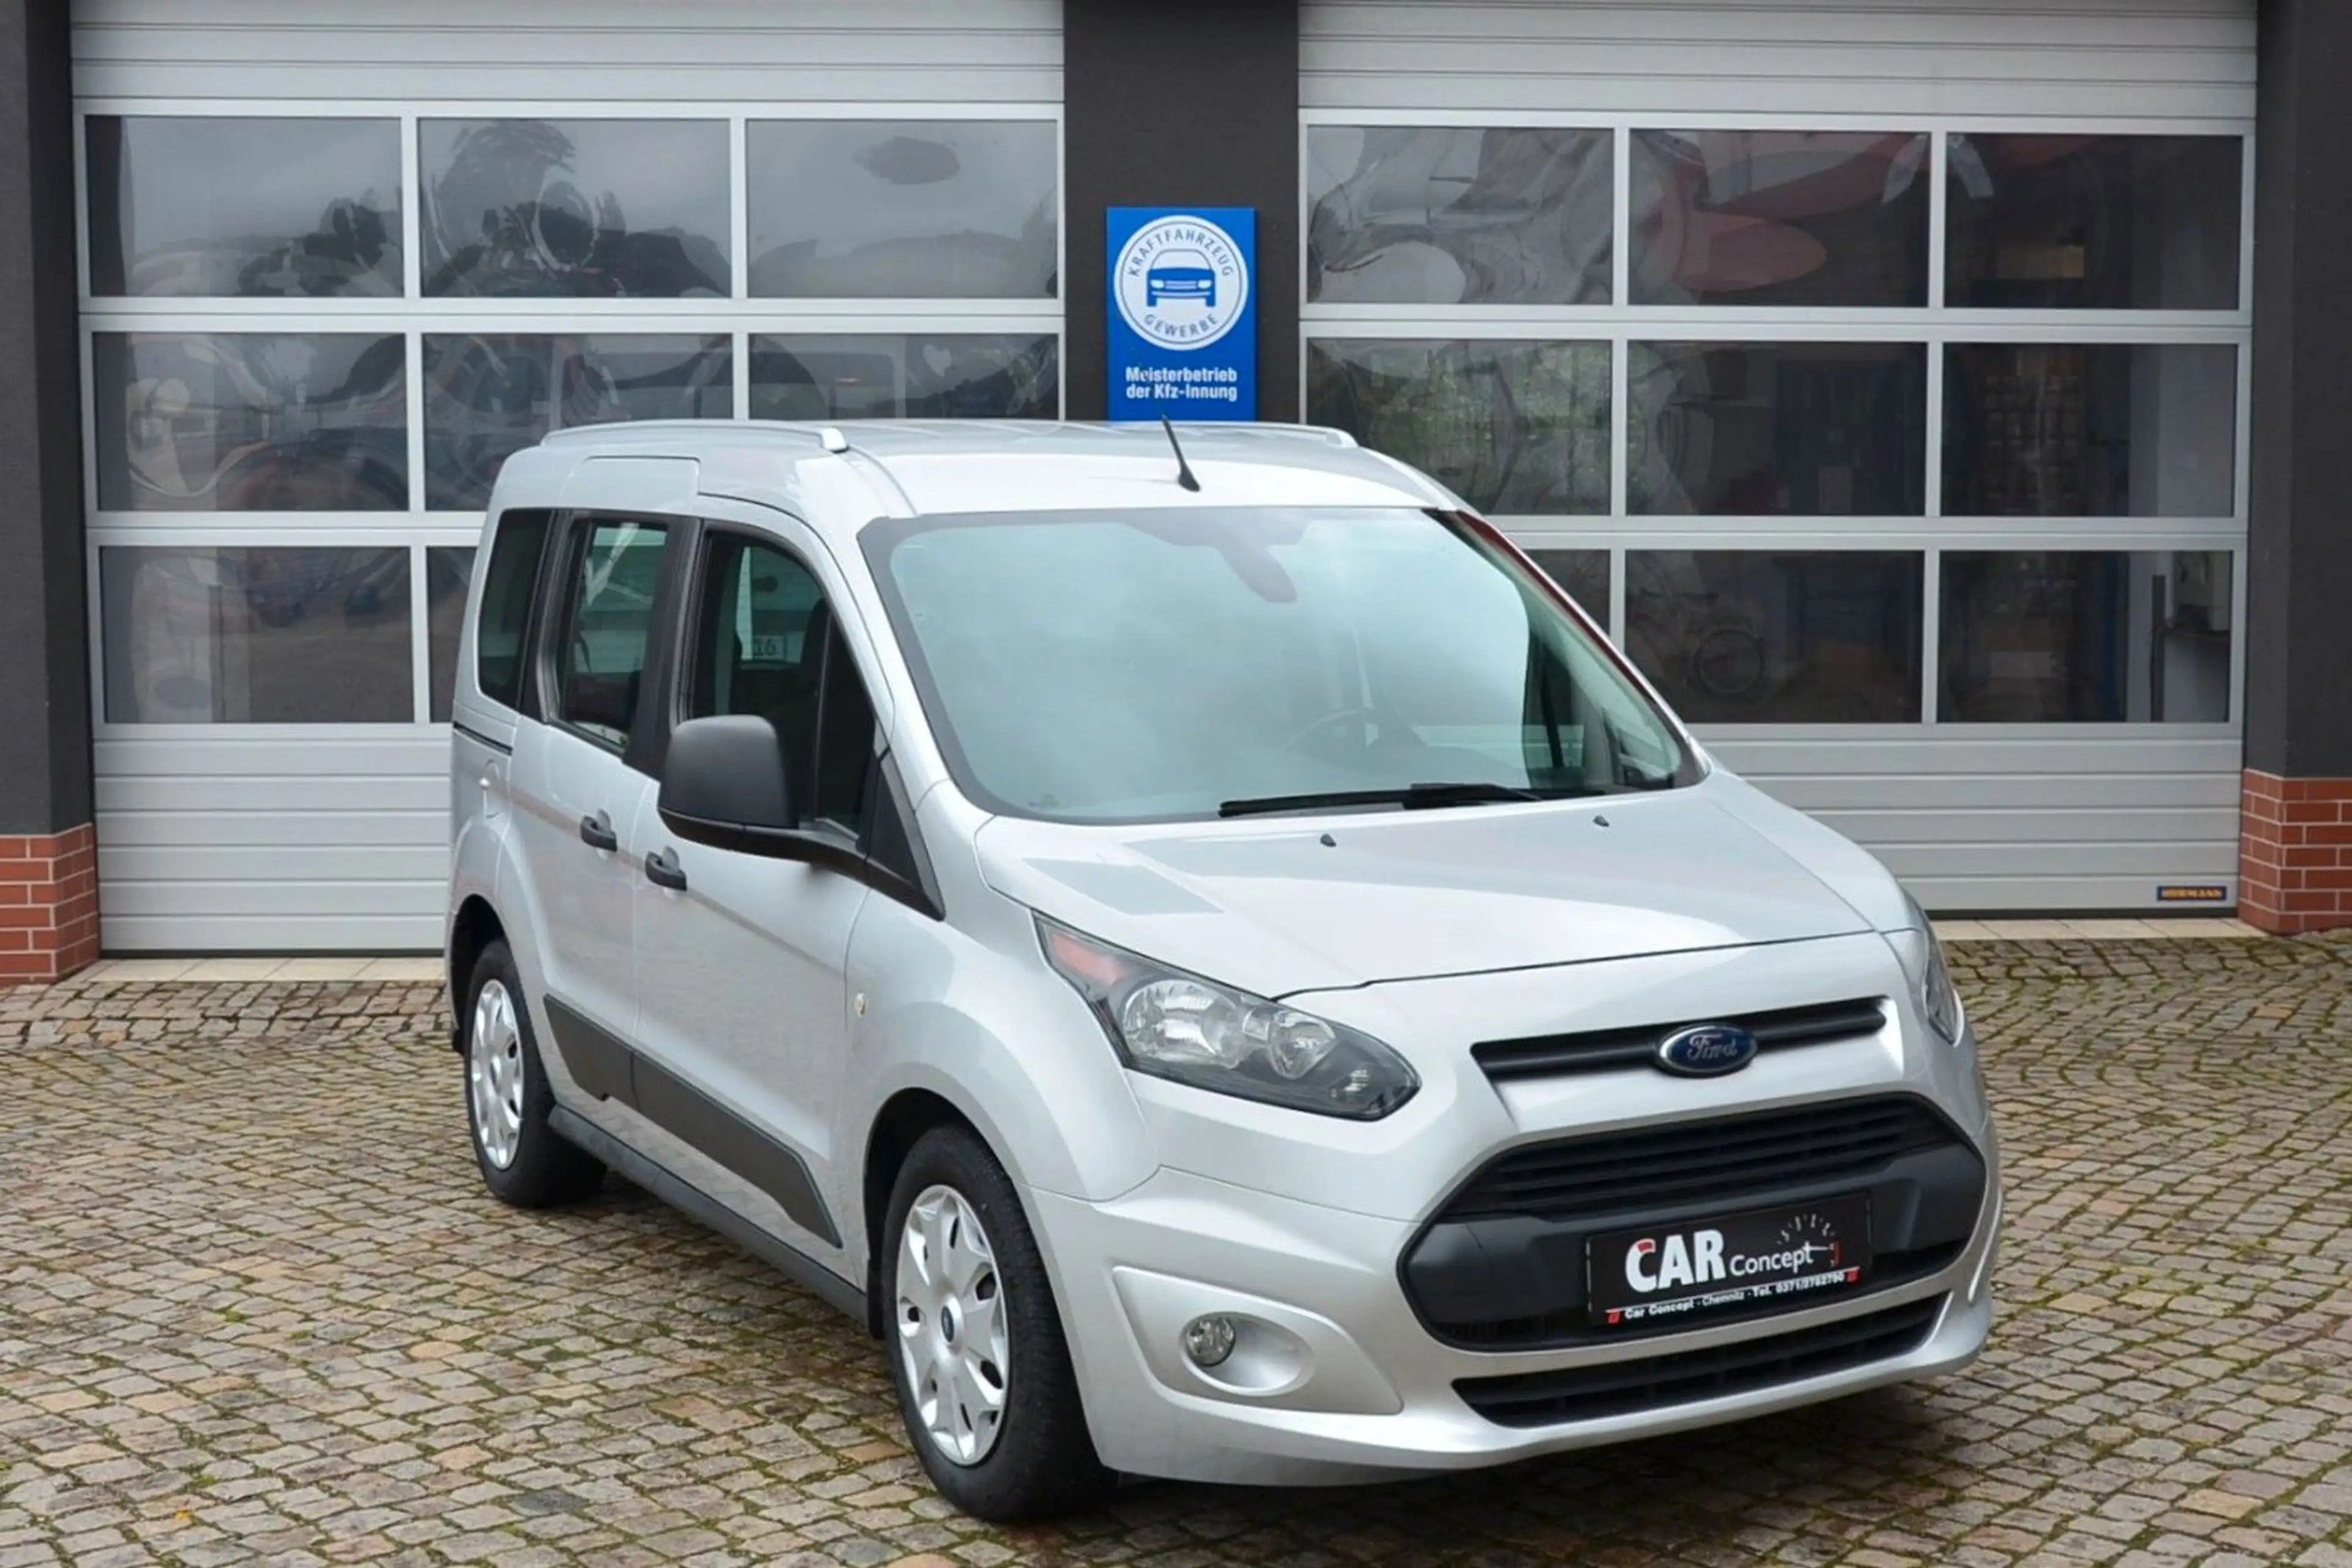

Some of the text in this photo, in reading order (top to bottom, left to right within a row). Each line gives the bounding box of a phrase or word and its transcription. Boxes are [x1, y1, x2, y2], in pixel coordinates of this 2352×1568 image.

[1128, 228, 1234, 277] KRAFTFAHRZEUG
[1144, 313, 1218, 337] GEWERBE
[1125, 366, 1237, 382] Meisterbetrieb
[1126, 384, 1237, 402] der Kfz-Innung
[1687, 1033, 1738, 1060] Ford
[1625, 1229, 1814, 1293] CAR Concept
[1624, 1308, 1645, 1319] Car
[1648, 1299, 1694, 1315] Concept
